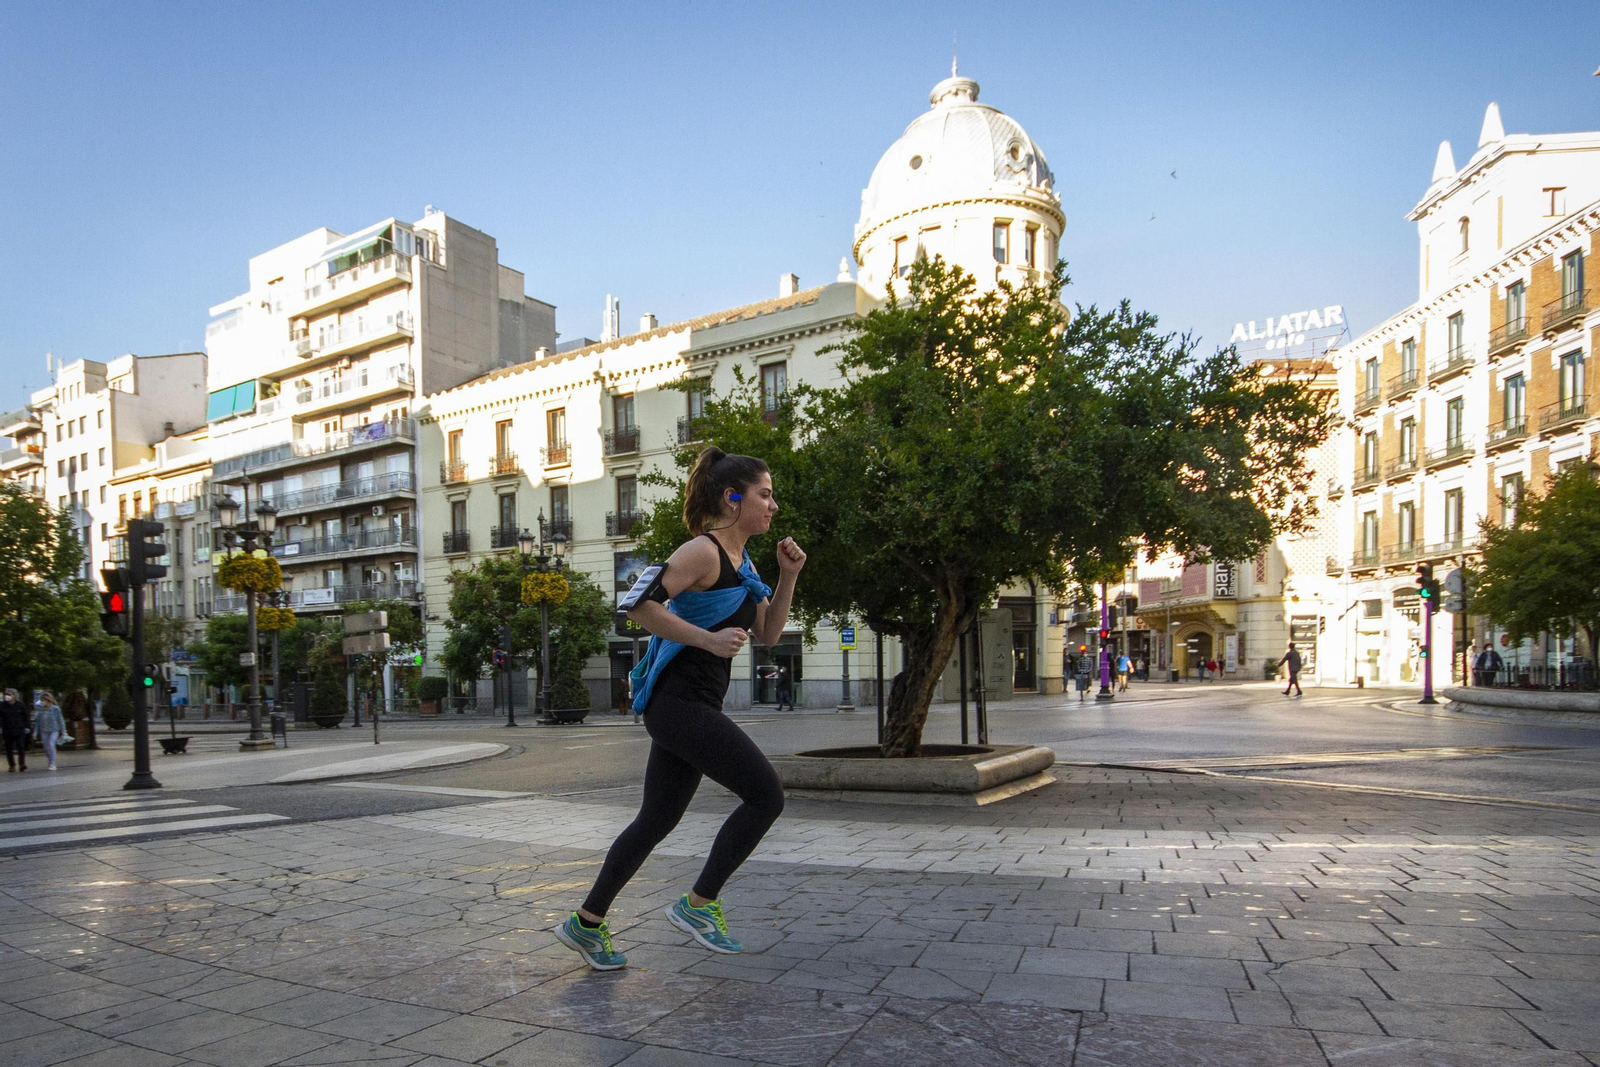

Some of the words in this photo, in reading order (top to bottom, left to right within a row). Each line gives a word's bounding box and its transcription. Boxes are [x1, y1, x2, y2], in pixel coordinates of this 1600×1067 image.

[1230, 305, 1344, 343] ALIATAR
[1215, 561, 1228, 595] Blan
[626, 620, 642, 630] 9:0
